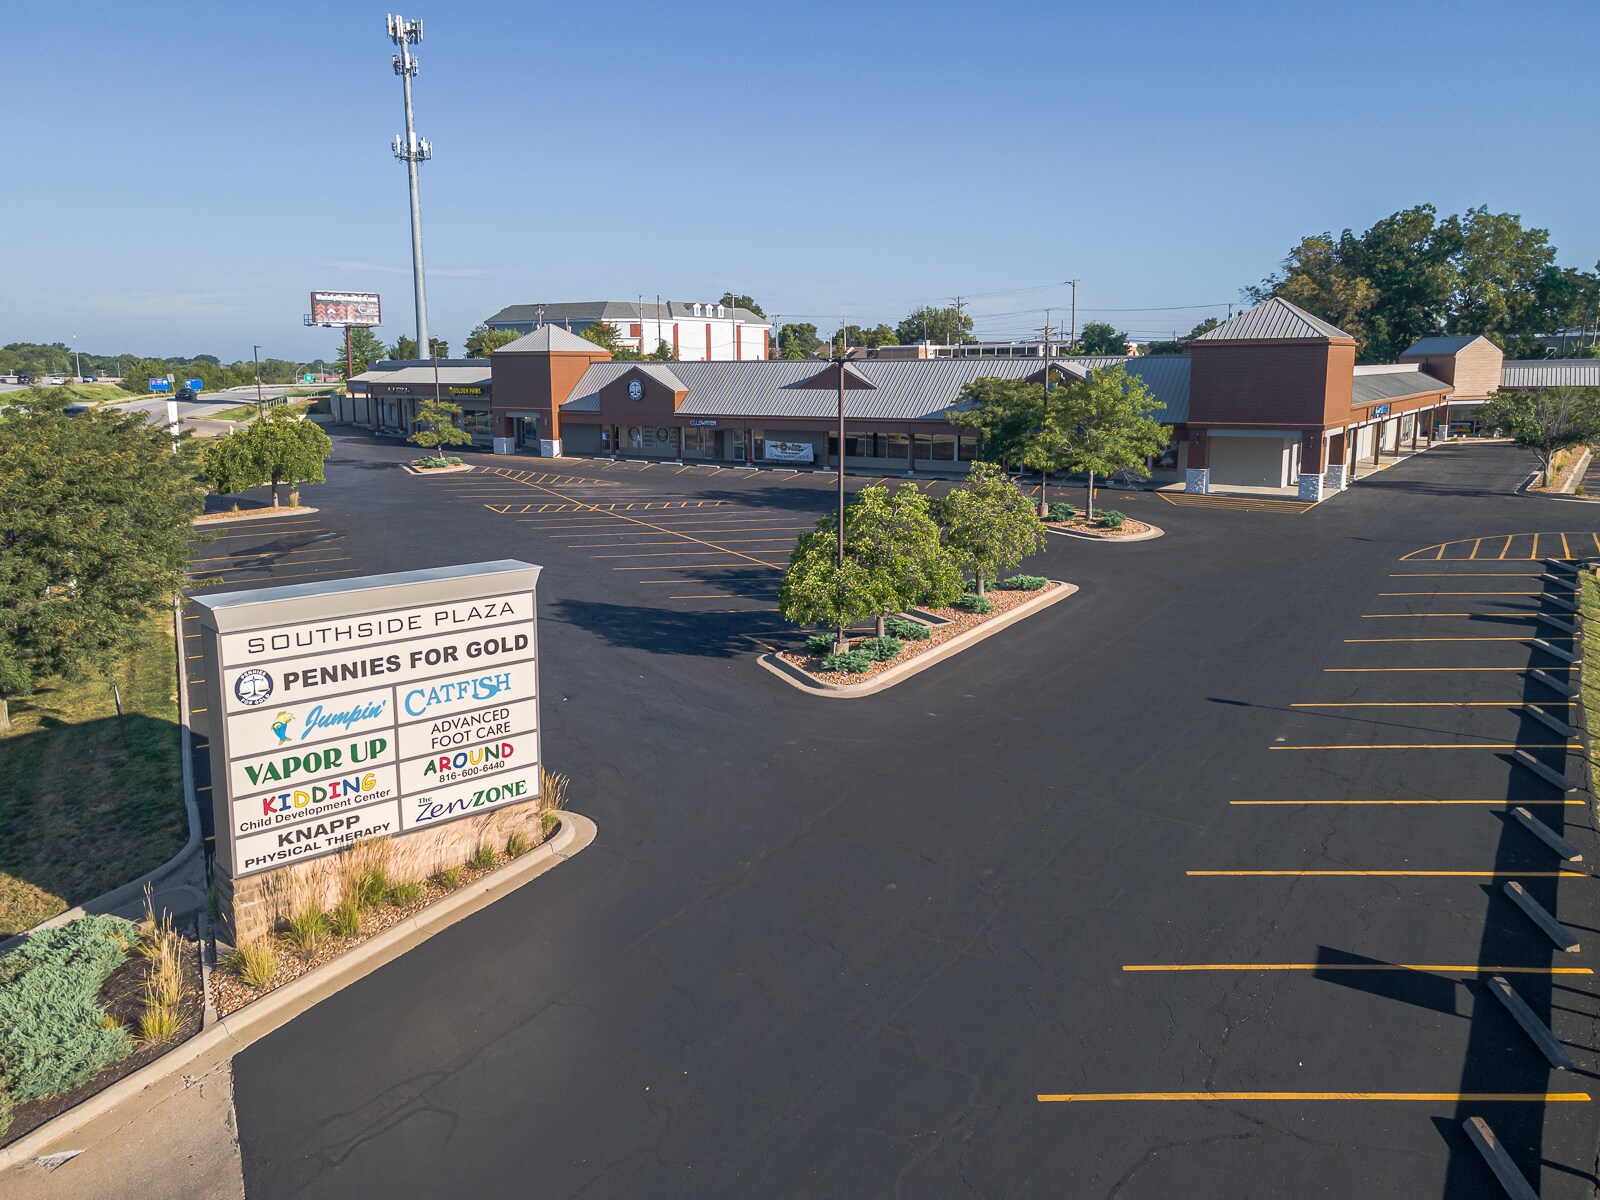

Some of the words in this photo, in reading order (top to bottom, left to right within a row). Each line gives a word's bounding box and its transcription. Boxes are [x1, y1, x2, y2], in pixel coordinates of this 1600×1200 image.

[248, 615, 422, 653] SOUTHSIDE
[434, 602, 514, 624] PLAZA
[240, 669, 266, 680] PENNIES
[284, 655, 400, 690] PENNIES
[410, 646, 458, 670] FOR
[466, 634, 528, 658] GOLD
[254, 693, 270, 705] GOLD
[405, 673, 512, 716] CATFISH
[301, 700, 386, 740] Jumpin'
[431, 708, 510, 734] ADVANCED
[432, 730, 470, 750] FOOT
[476, 722, 510, 740] CARE
[244, 748, 342, 786] VAPOR
[350, 738, 387, 764] UP
[424, 742, 514, 776] AROUND
[439, 760, 505, 782] 816-600-6440
[240, 816, 272, 832] Child
[276, 798, 351, 824] Development
[354, 788, 390, 808] Center
[262, 772, 376, 816] KIDDING
[418, 796, 432, 804] The
[244, 842, 322, 868] PHYSICAL
[326, 822, 390, 846] THERAPY
[278, 815, 360, 847] KNAPP
